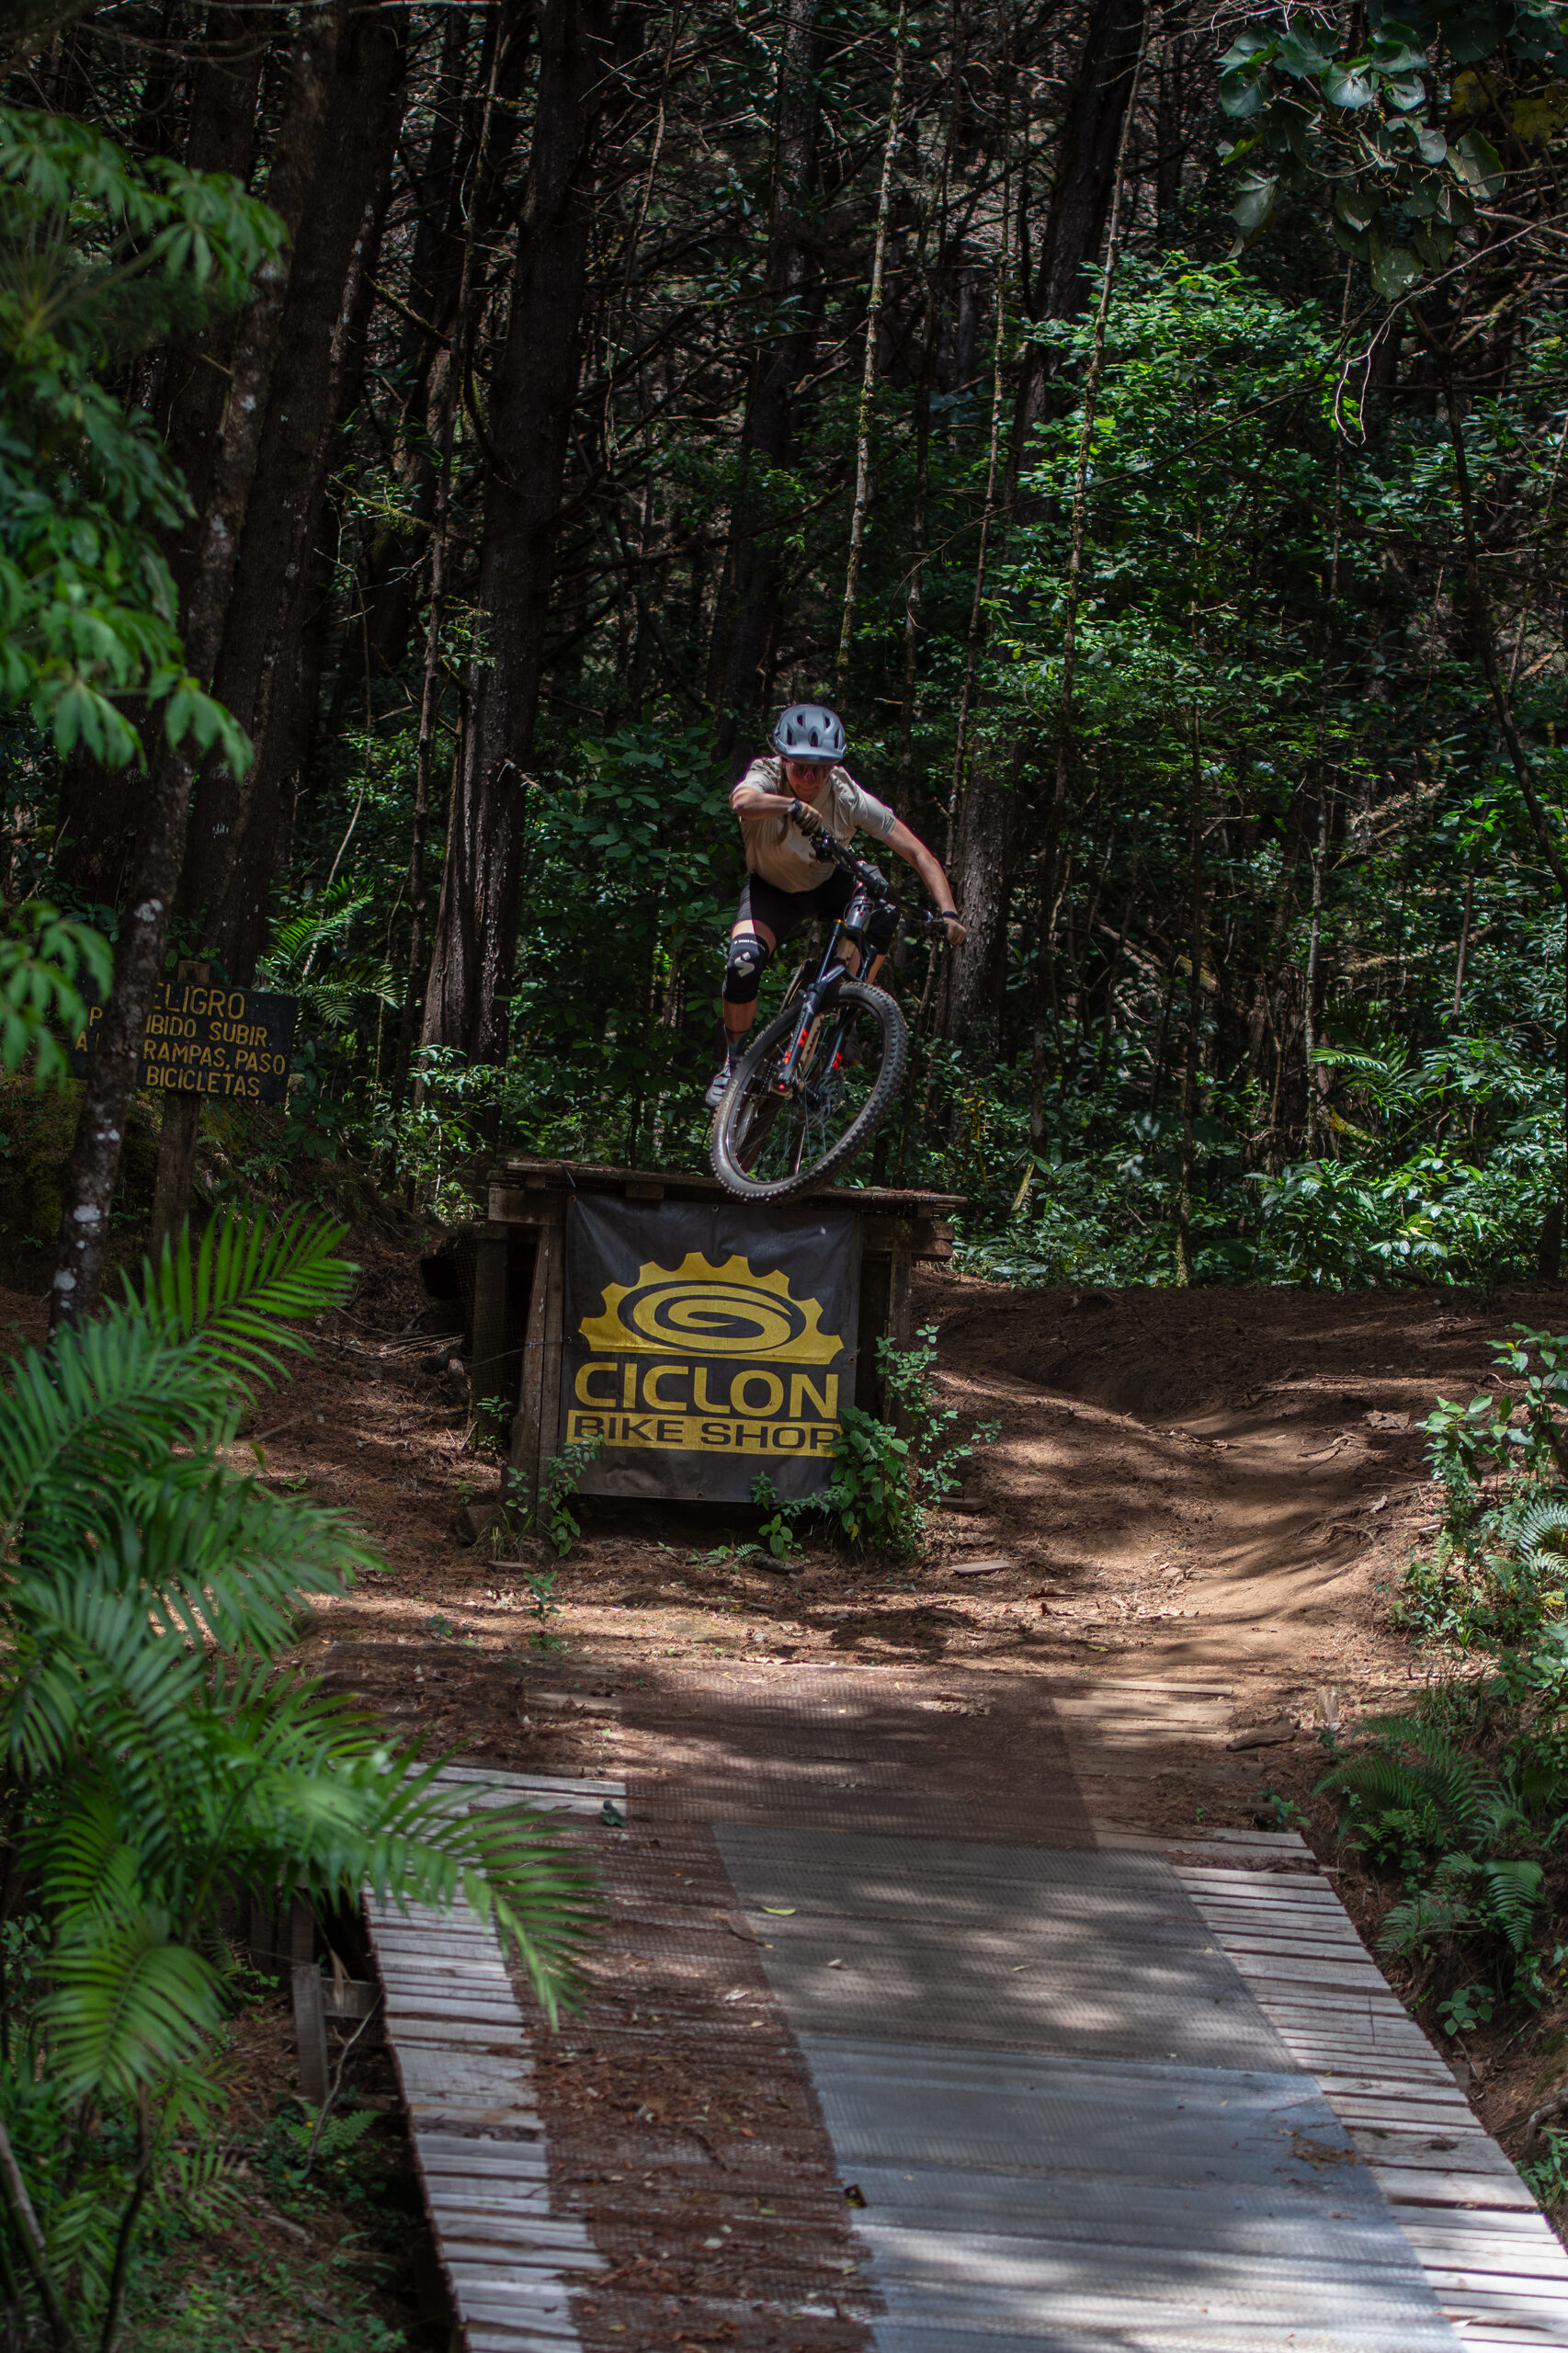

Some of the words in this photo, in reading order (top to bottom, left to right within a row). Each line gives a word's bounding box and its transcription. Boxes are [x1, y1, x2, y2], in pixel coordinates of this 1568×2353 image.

[209, 1021, 267, 1047] SUBIR
[142, 1039, 231, 1072] RAMPAS,
[234, 1049, 285, 1075] PASO
[145, 1065, 260, 1097] BICICLETAS
[574, 1361, 839, 1419] CICLON
[574, 1415, 684, 1443] BIKE
[701, 1422, 841, 1450] SHOP
